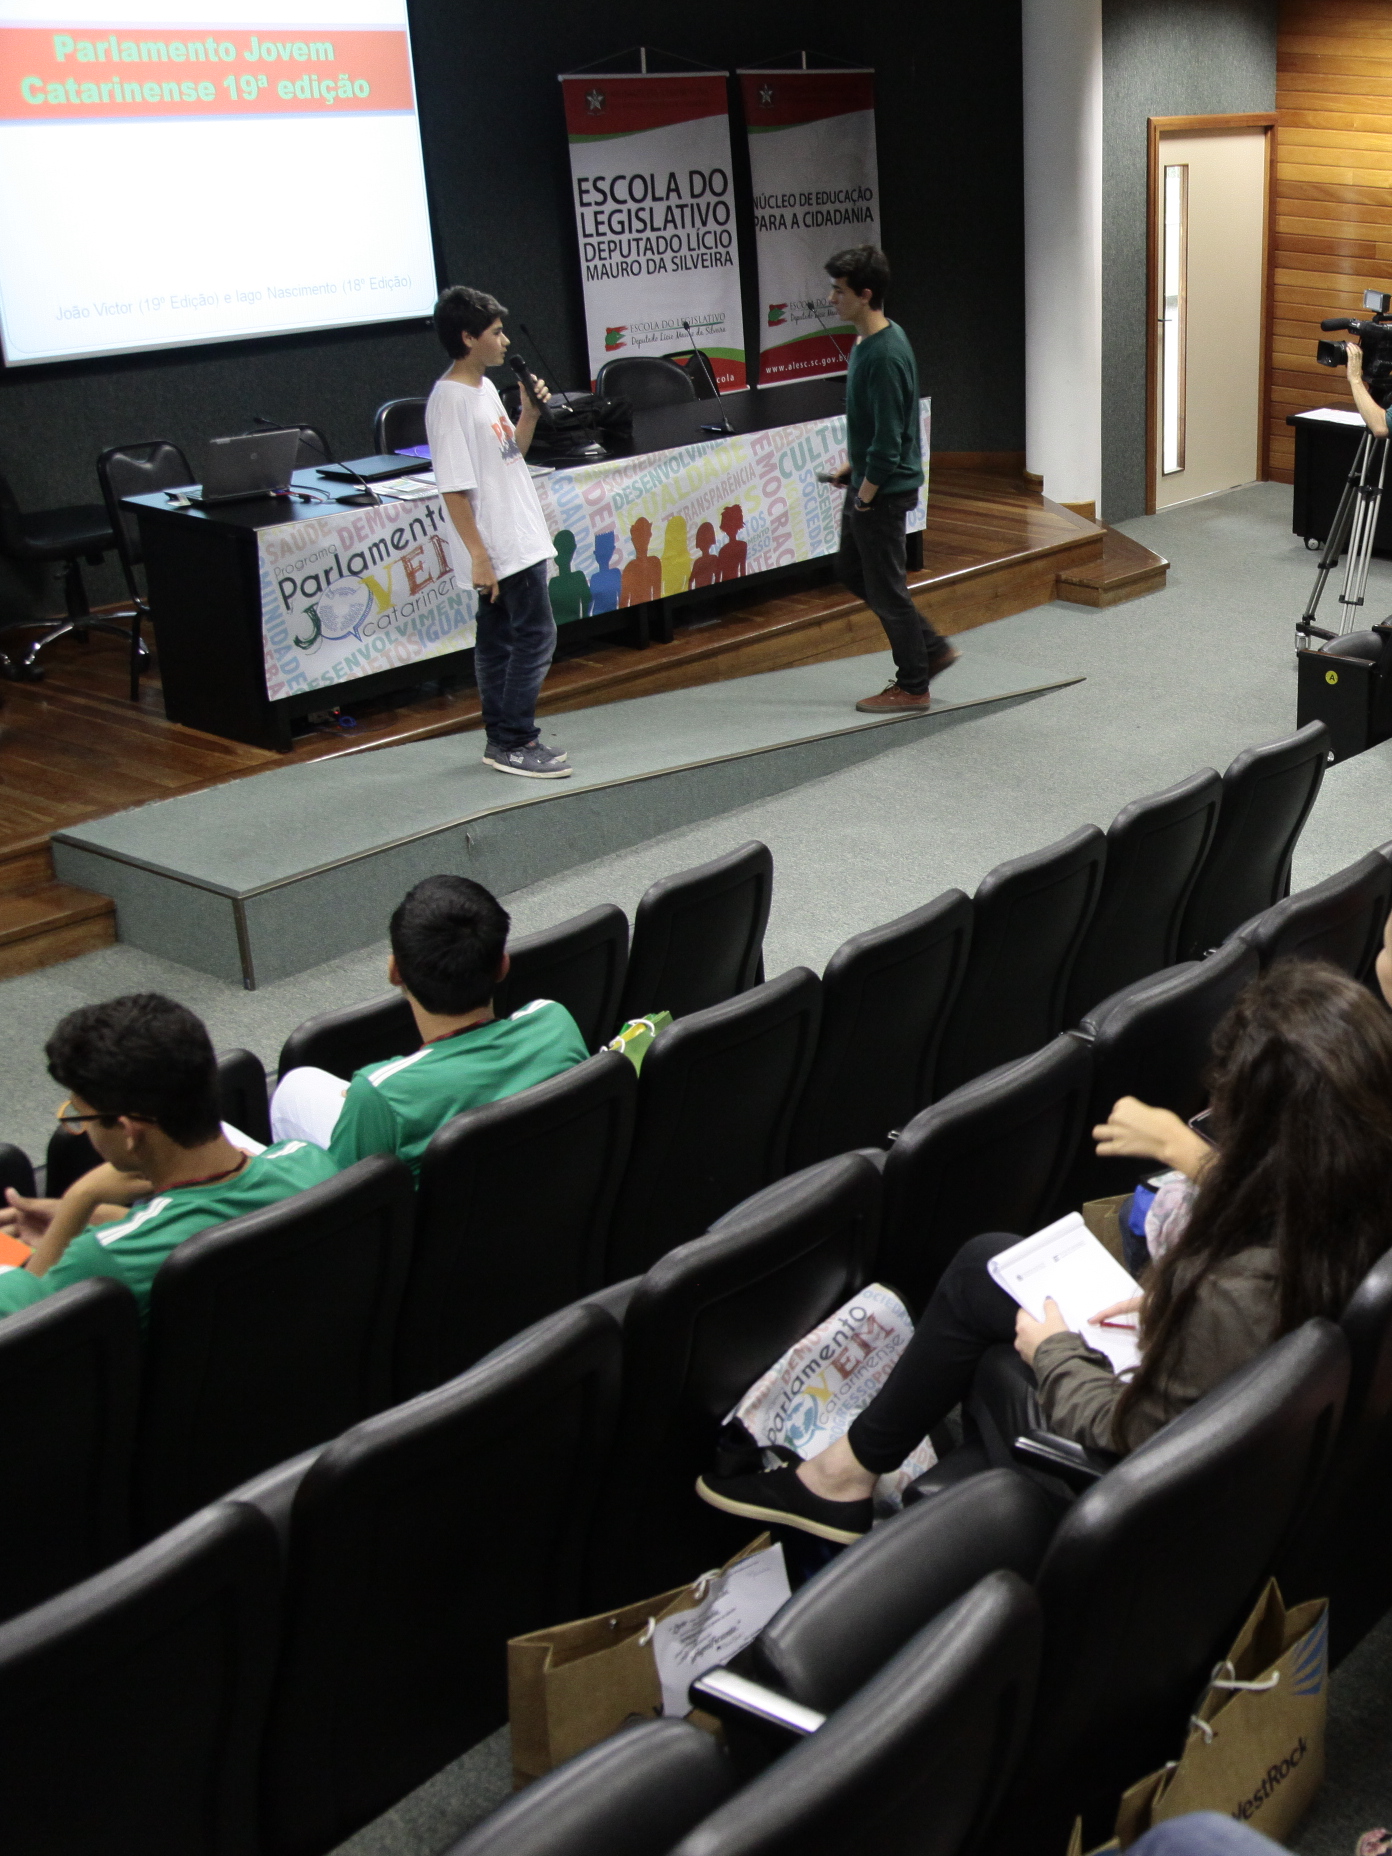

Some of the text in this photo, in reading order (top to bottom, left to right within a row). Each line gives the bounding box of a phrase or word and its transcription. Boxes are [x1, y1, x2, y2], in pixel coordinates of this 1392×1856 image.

[53, 34, 335, 62] Parlamento Jovem
[20, 75, 216, 104] Catarinense
[277, 73, 371, 105] edição
[577, 168, 728, 207] ESCOLA DO
[753, 186, 873, 210] NÚCLEO DE EDUCAÇÃO
[581, 201, 731, 238] LEGISLATIVO
[754, 207, 874, 231] PARA A CIDADANIA
[584, 228, 732, 262] DEPUTADO LÍCIO
[586, 251, 733, 281] MAURO DA SILVEIRA
[56, 305, 90, 321] João
[93, 302, 133, 317] Victor
[170, 292, 219, 310] Edição)
[224, 294, 232, 303] e
[267, 282, 337, 299] Nascimento
[370, 274, 412, 291] Edição)
[630, 321, 660, 333] ESCOLA
[661, 319, 674, 328] DO
[778, 416, 848, 480] CULTU
[675, 462, 757, 524] TRANSPARÊNCIA
[274, 544, 337, 580] Programa
[418, 603, 476, 648] IGUAL
